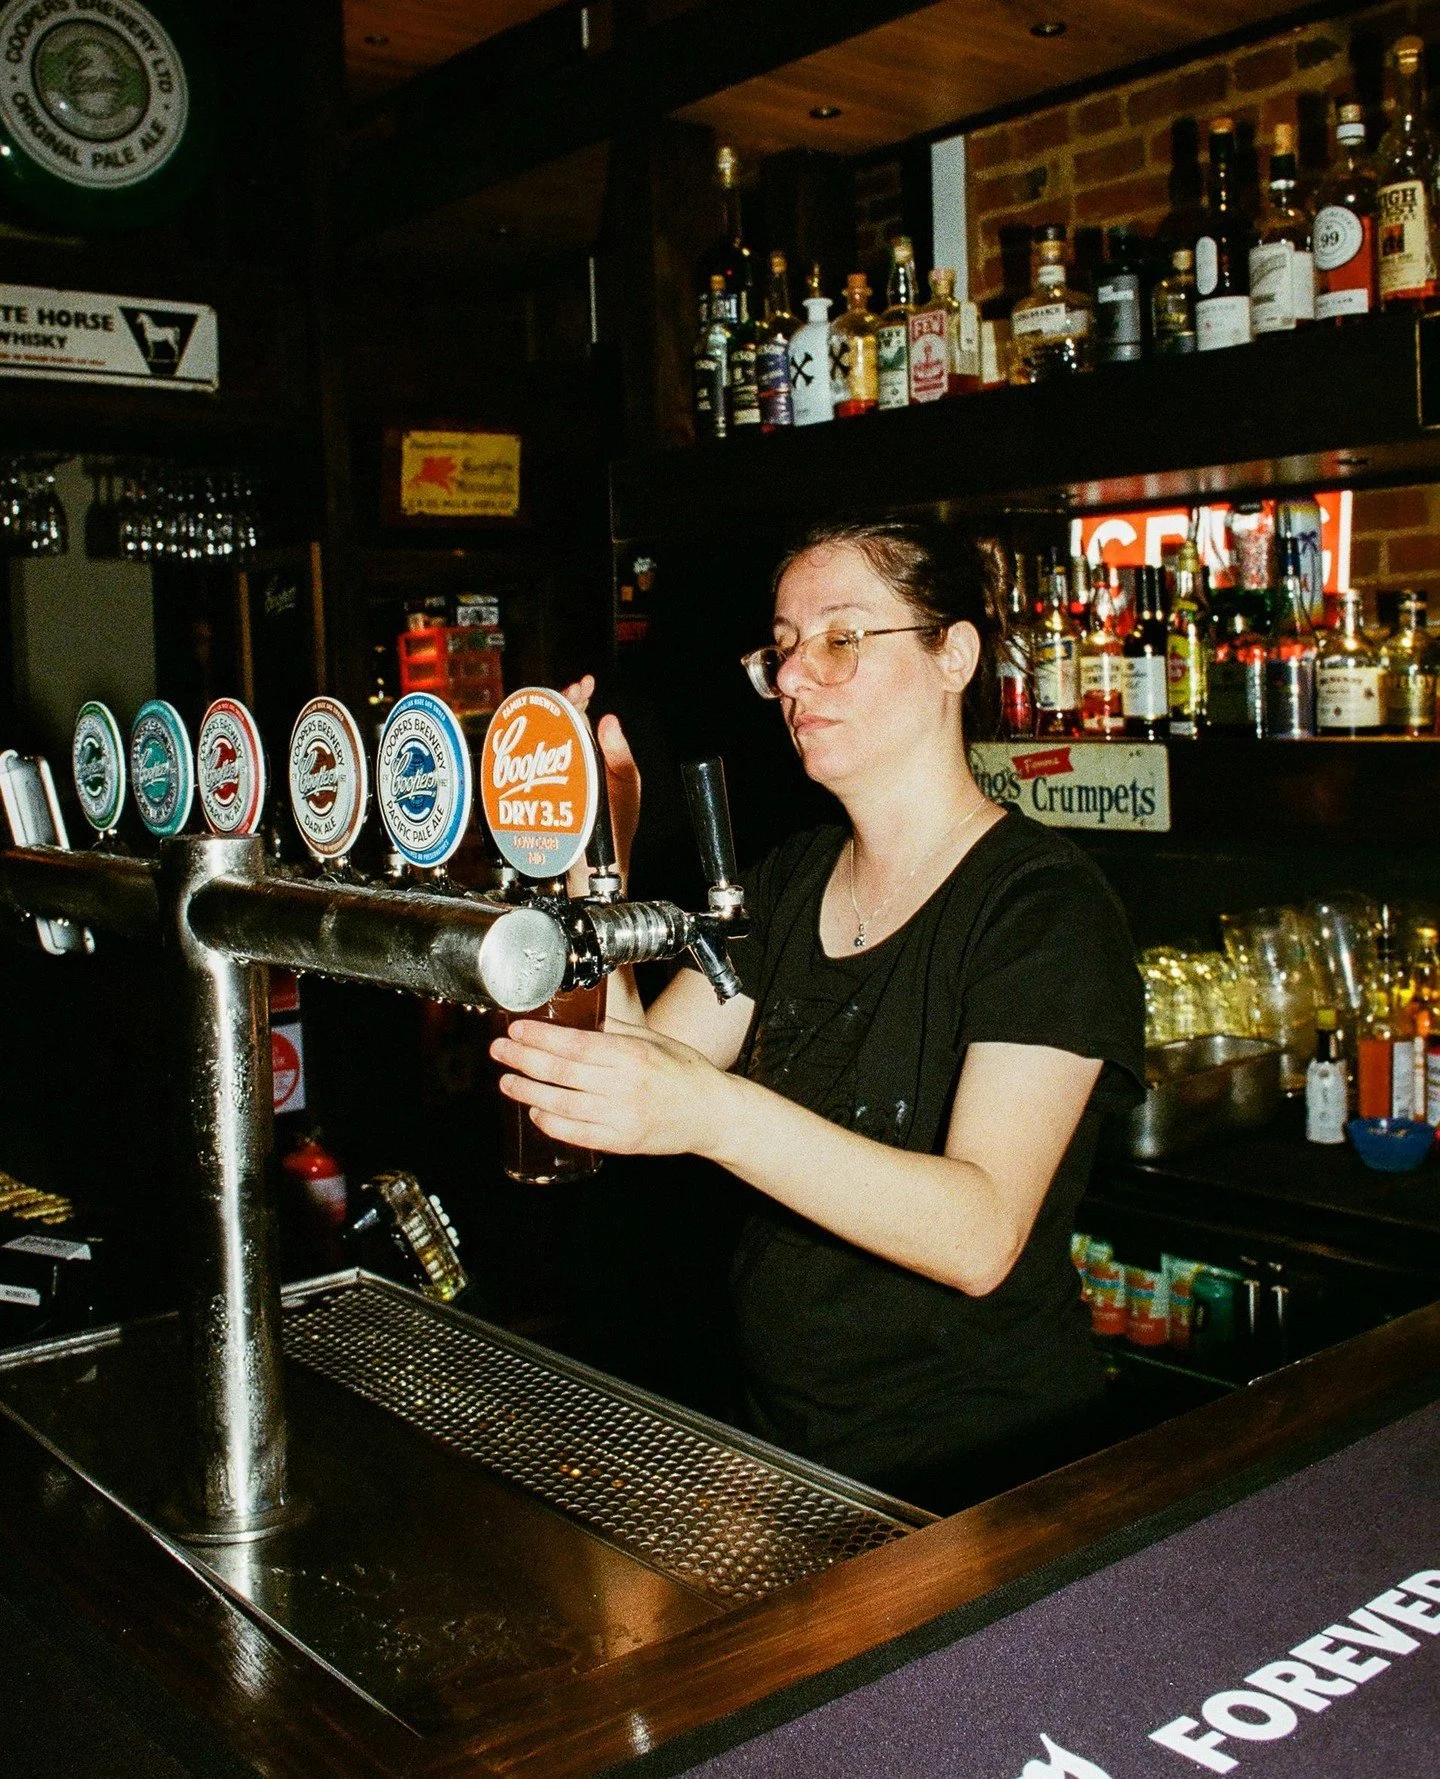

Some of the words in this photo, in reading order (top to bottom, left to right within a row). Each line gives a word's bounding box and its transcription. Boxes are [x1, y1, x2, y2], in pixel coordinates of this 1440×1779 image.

[5, 0, 69, 63] COOPERS
[76, 0, 157, 53] BREWERY
[152, 58, 174, 93] LTD
[12, 92, 82, 166] ORIGINAL
[91, 146, 136, 170] PALE
[140, 118, 167, 152] ALE
[0, 304, 28, 324] TE
[36, 307, 116, 332] HORSE
[502, 694, 527, 720] FAMILY
[529, 695, 561, 718] BREWED
[293, 719, 317, 766] COOPERS
[318, 719, 345, 767] BREWERY
[383, 718, 413, 766] COOPERS
[414, 718, 446, 770] BREWERY
[492, 715, 573, 793] Coopers
[390, 751, 436, 797] Coopers
[974, 765, 1022, 803] ing's
[1031, 776, 1156, 824] Crumpets
[234, 795, 243, 814] ALE
[303, 814, 323, 836] DARK
[324, 815, 337, 834] ALE
[386, 800, 412, 842] PACIFIC
[413, 826, 432, 843] PALE
[433, 805, 445, 828] ALE
[499, 800, 539, 826] DRY
[540, 801, 574, 828] 3.5
